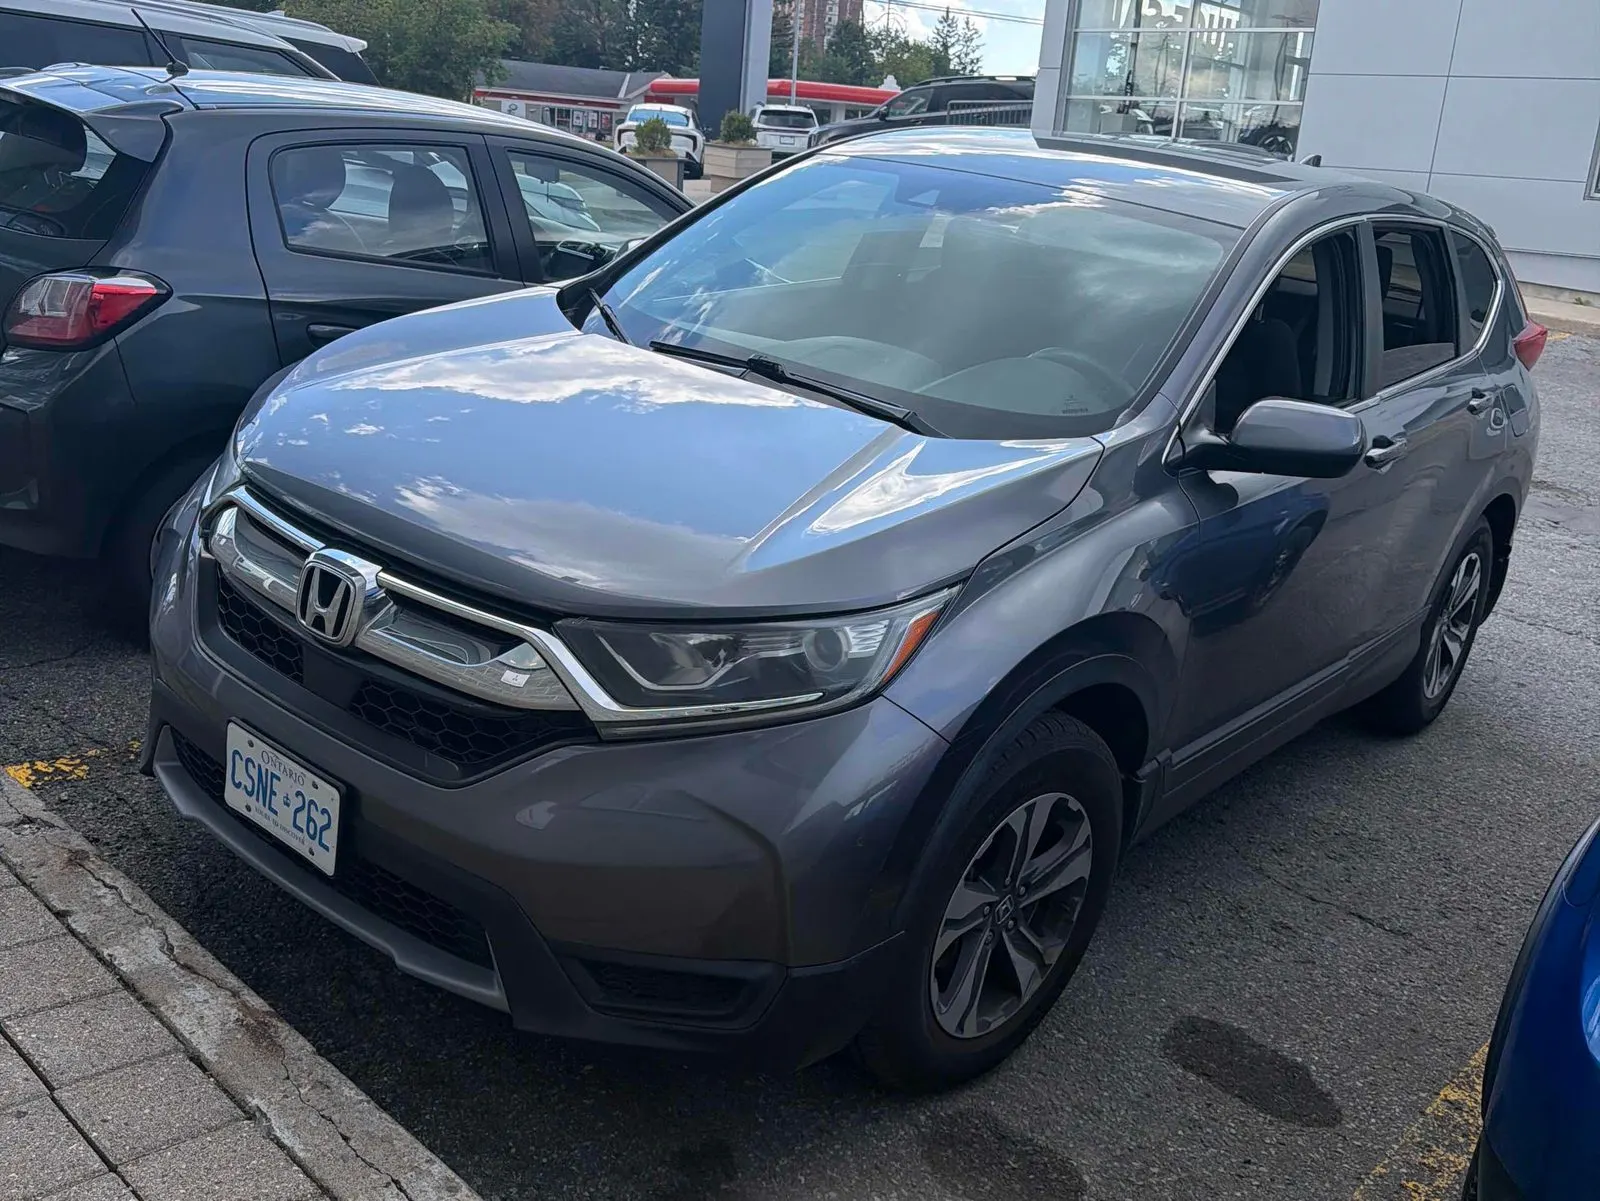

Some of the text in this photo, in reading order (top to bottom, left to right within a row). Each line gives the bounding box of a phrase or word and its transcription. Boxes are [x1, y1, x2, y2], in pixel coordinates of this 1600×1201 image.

[231, 749, 332, 853] CSNE 262
[261, 750, 306, 787] ONTARIO
